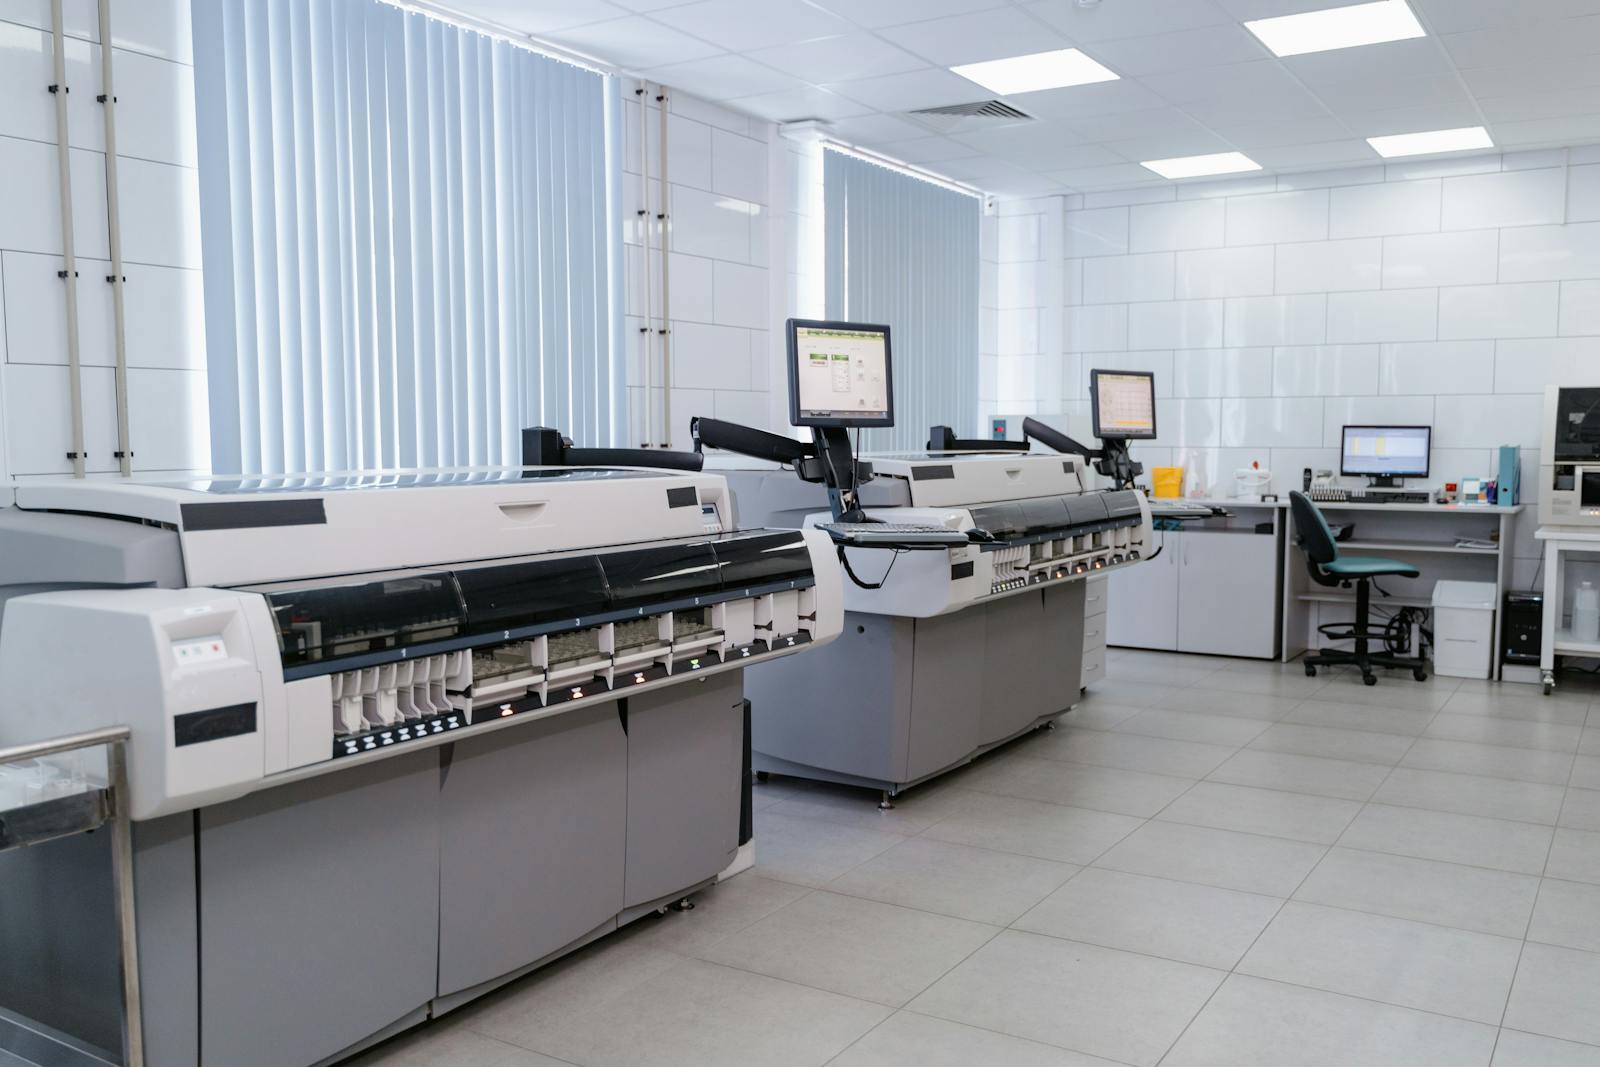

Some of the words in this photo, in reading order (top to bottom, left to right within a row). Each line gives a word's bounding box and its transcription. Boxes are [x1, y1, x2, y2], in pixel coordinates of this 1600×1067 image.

[575, 618, 581, 626] 3
[504, 630, 510, 639] 2
[401, 648, 406, 657] 1
